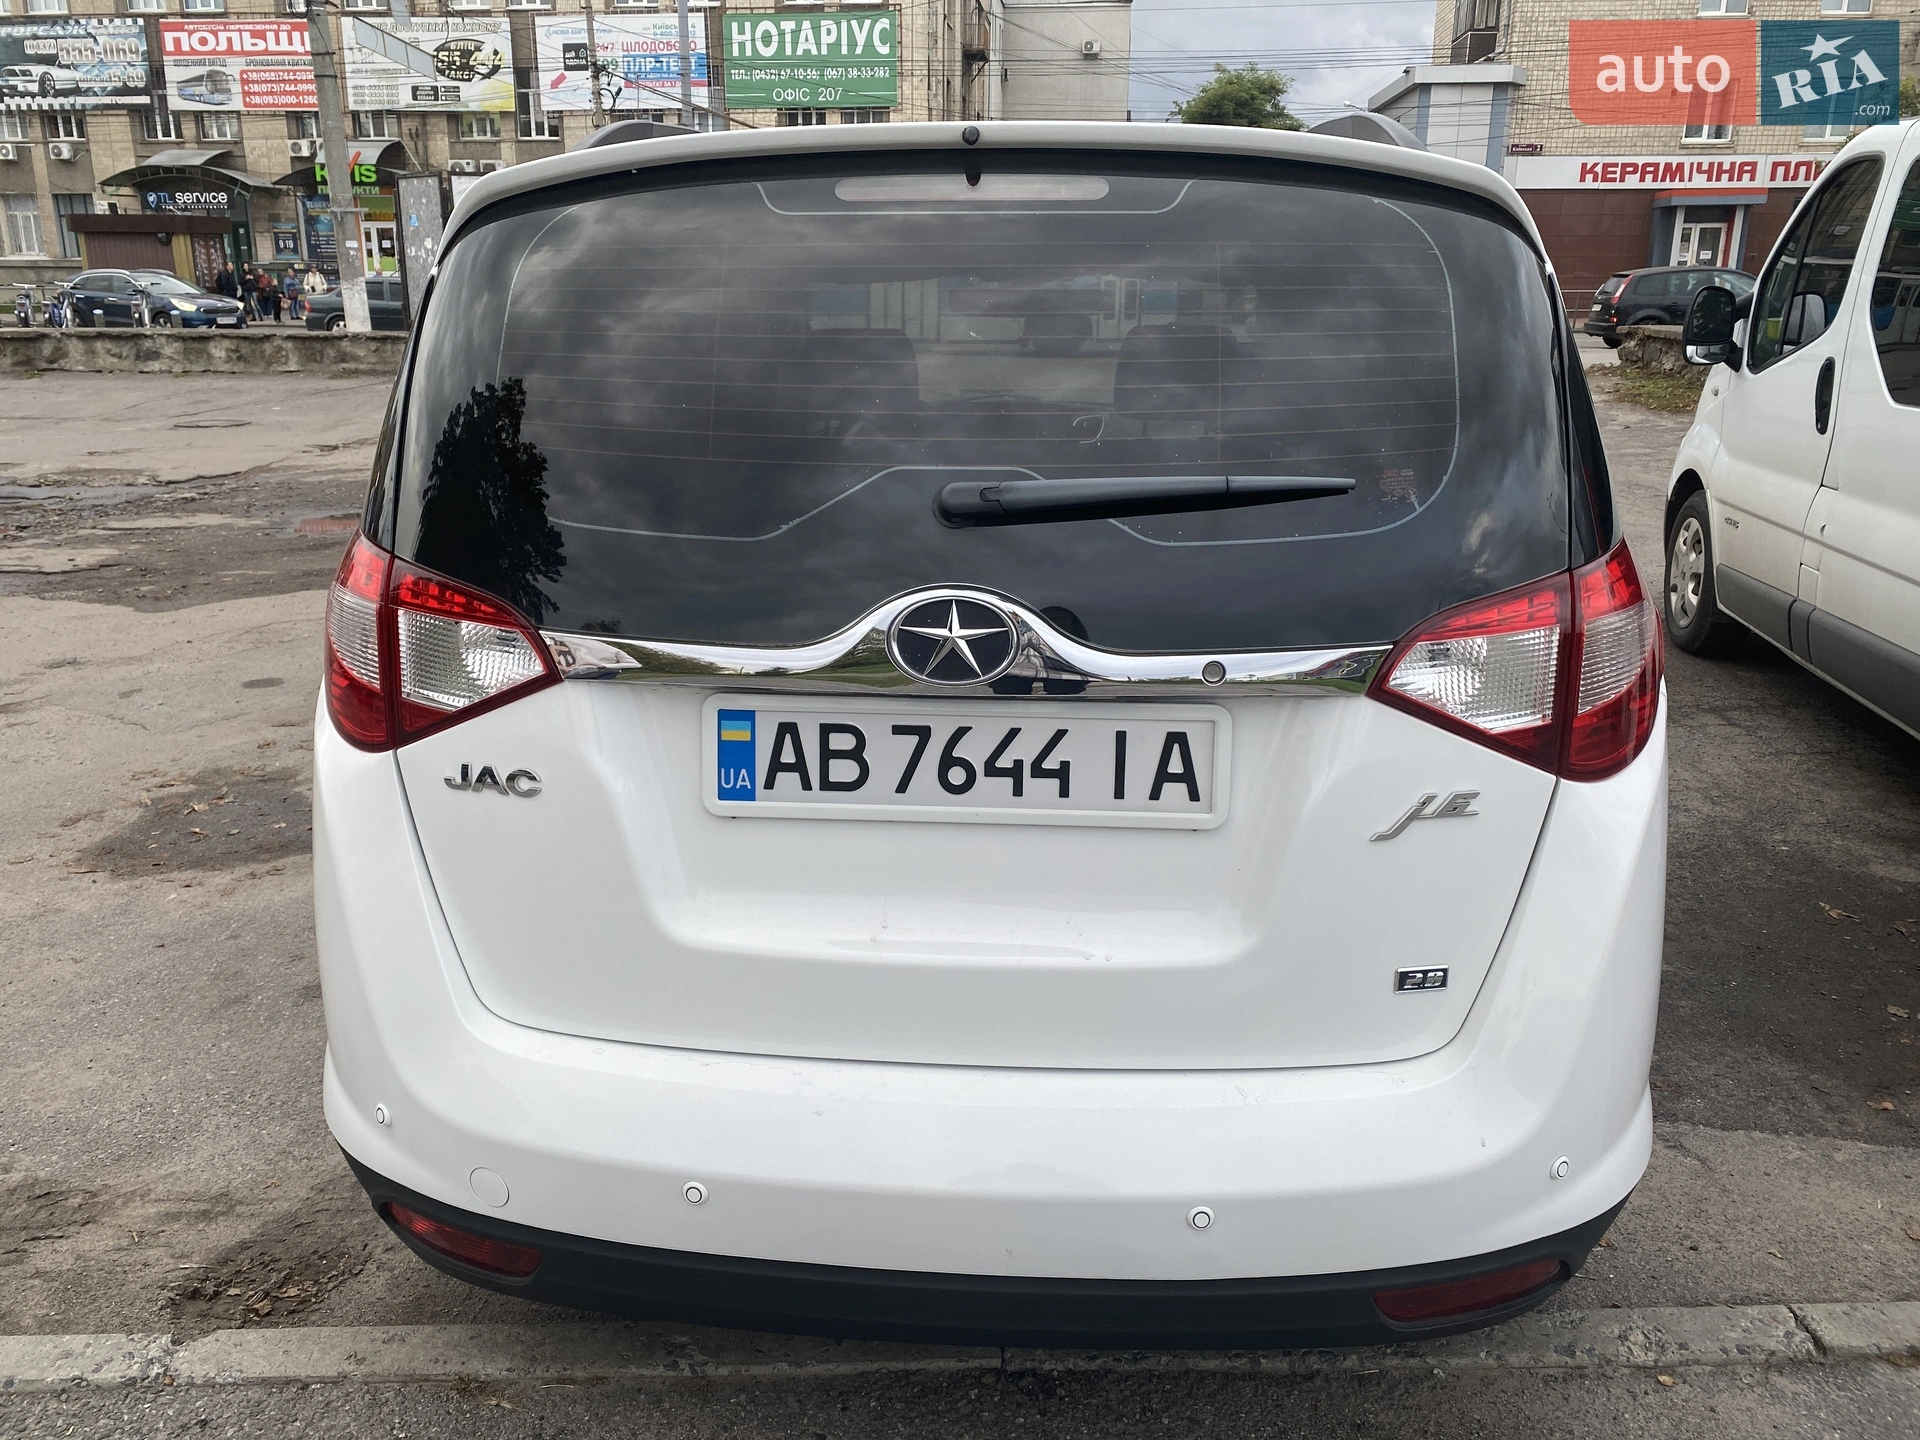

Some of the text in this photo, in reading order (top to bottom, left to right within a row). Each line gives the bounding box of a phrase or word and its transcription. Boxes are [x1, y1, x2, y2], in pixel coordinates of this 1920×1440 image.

[450, 41, 475, 51] БЛІЦ
[731, 18, 890, 57] НОТАРІУС
[58, 39, 140, 62] 555-069
[622, 41, 697, 53] ЦІЛОДОБОО
[433, 50, 505, 69] 55-444
[624, 57, 697, 71] ПЛР-ТЕТ
[752, 69, 778, 81] (0432)
[824, 67, 845, 80] (067)
[773, 88, 843, 101] ОФІС 207
[1579, 161, 1759, 182] КЕРАМІЧНА
[158, 192, 228, 203] TL service
[318, 185, 379, 195] ПУКТИ
[764, 721, 1201, 802] AB 7644 IA
[443, 762, 542, 798] JAC
[720, 769, 752, 789] UA
[1403, 971, 1444, 989] 2.0
